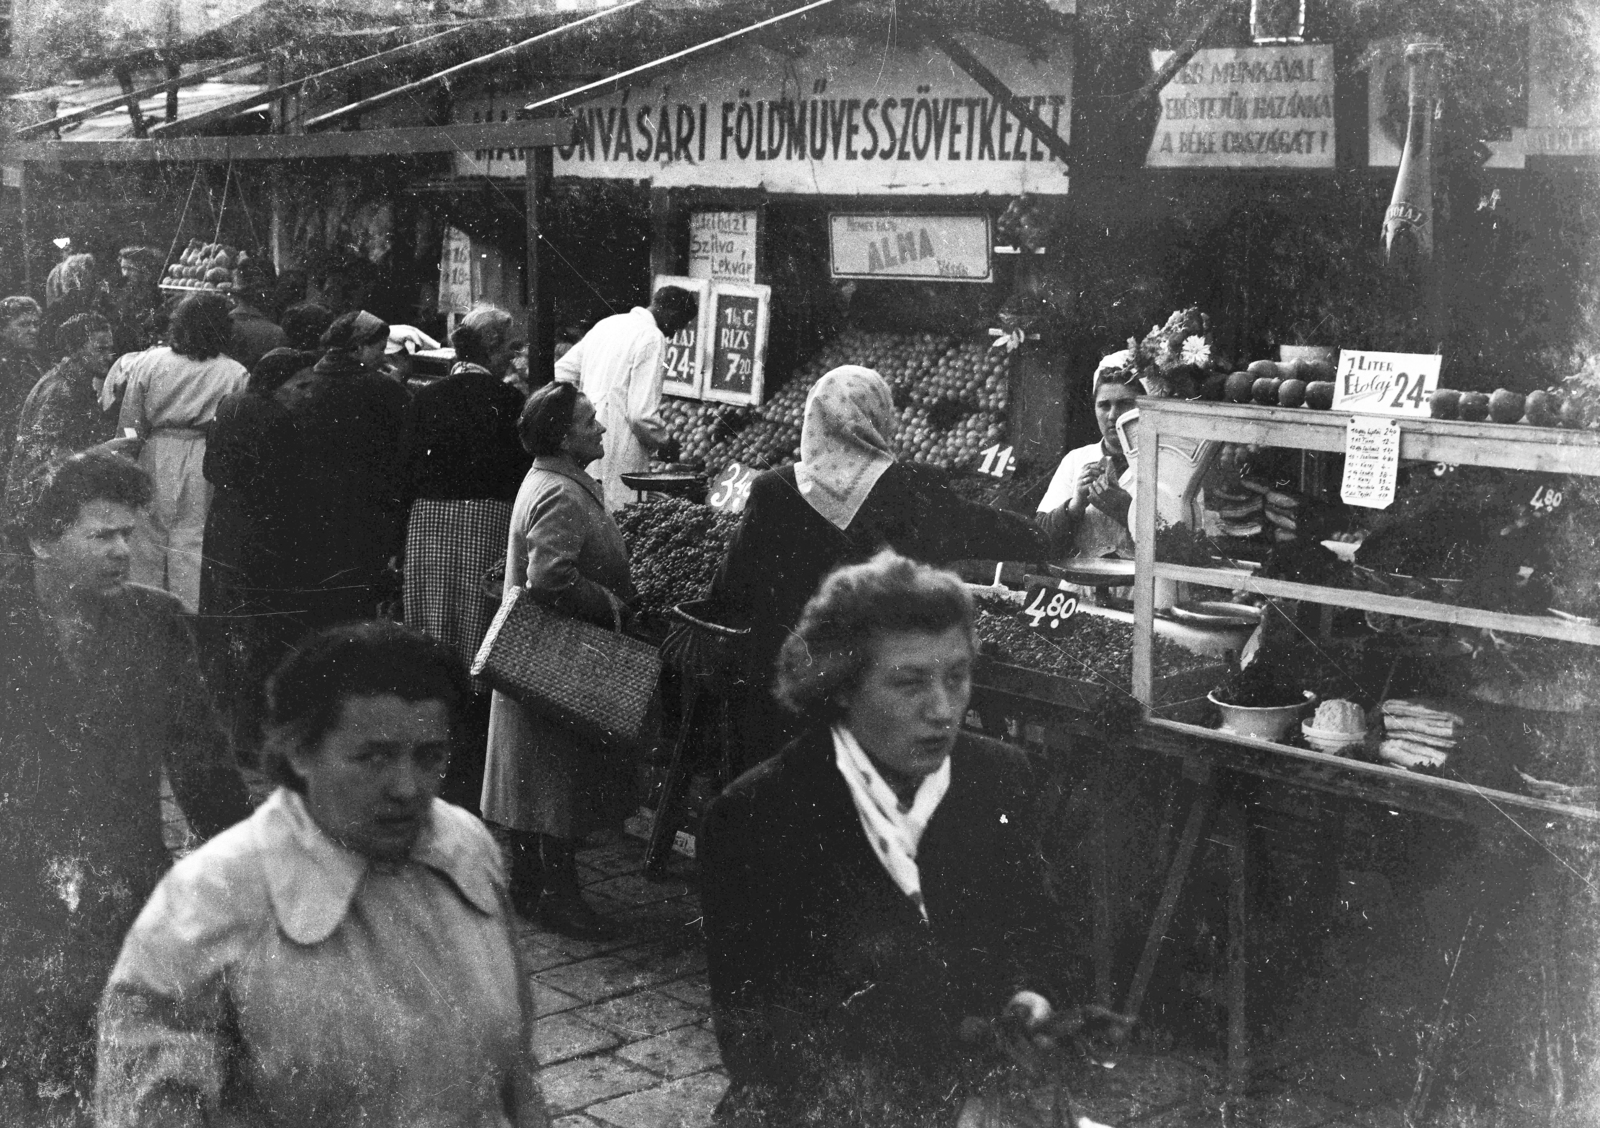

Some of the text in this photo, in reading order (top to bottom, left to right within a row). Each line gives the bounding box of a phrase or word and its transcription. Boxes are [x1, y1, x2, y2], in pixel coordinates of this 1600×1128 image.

[1160, 130, 1174, 153] A
[867, 227, 936, 273] ALMA
[720, 327, 751, 350] RIZS
[1347, 357, 1356, 371] 1
[1343, 369, 1394, 403] Étolaj
